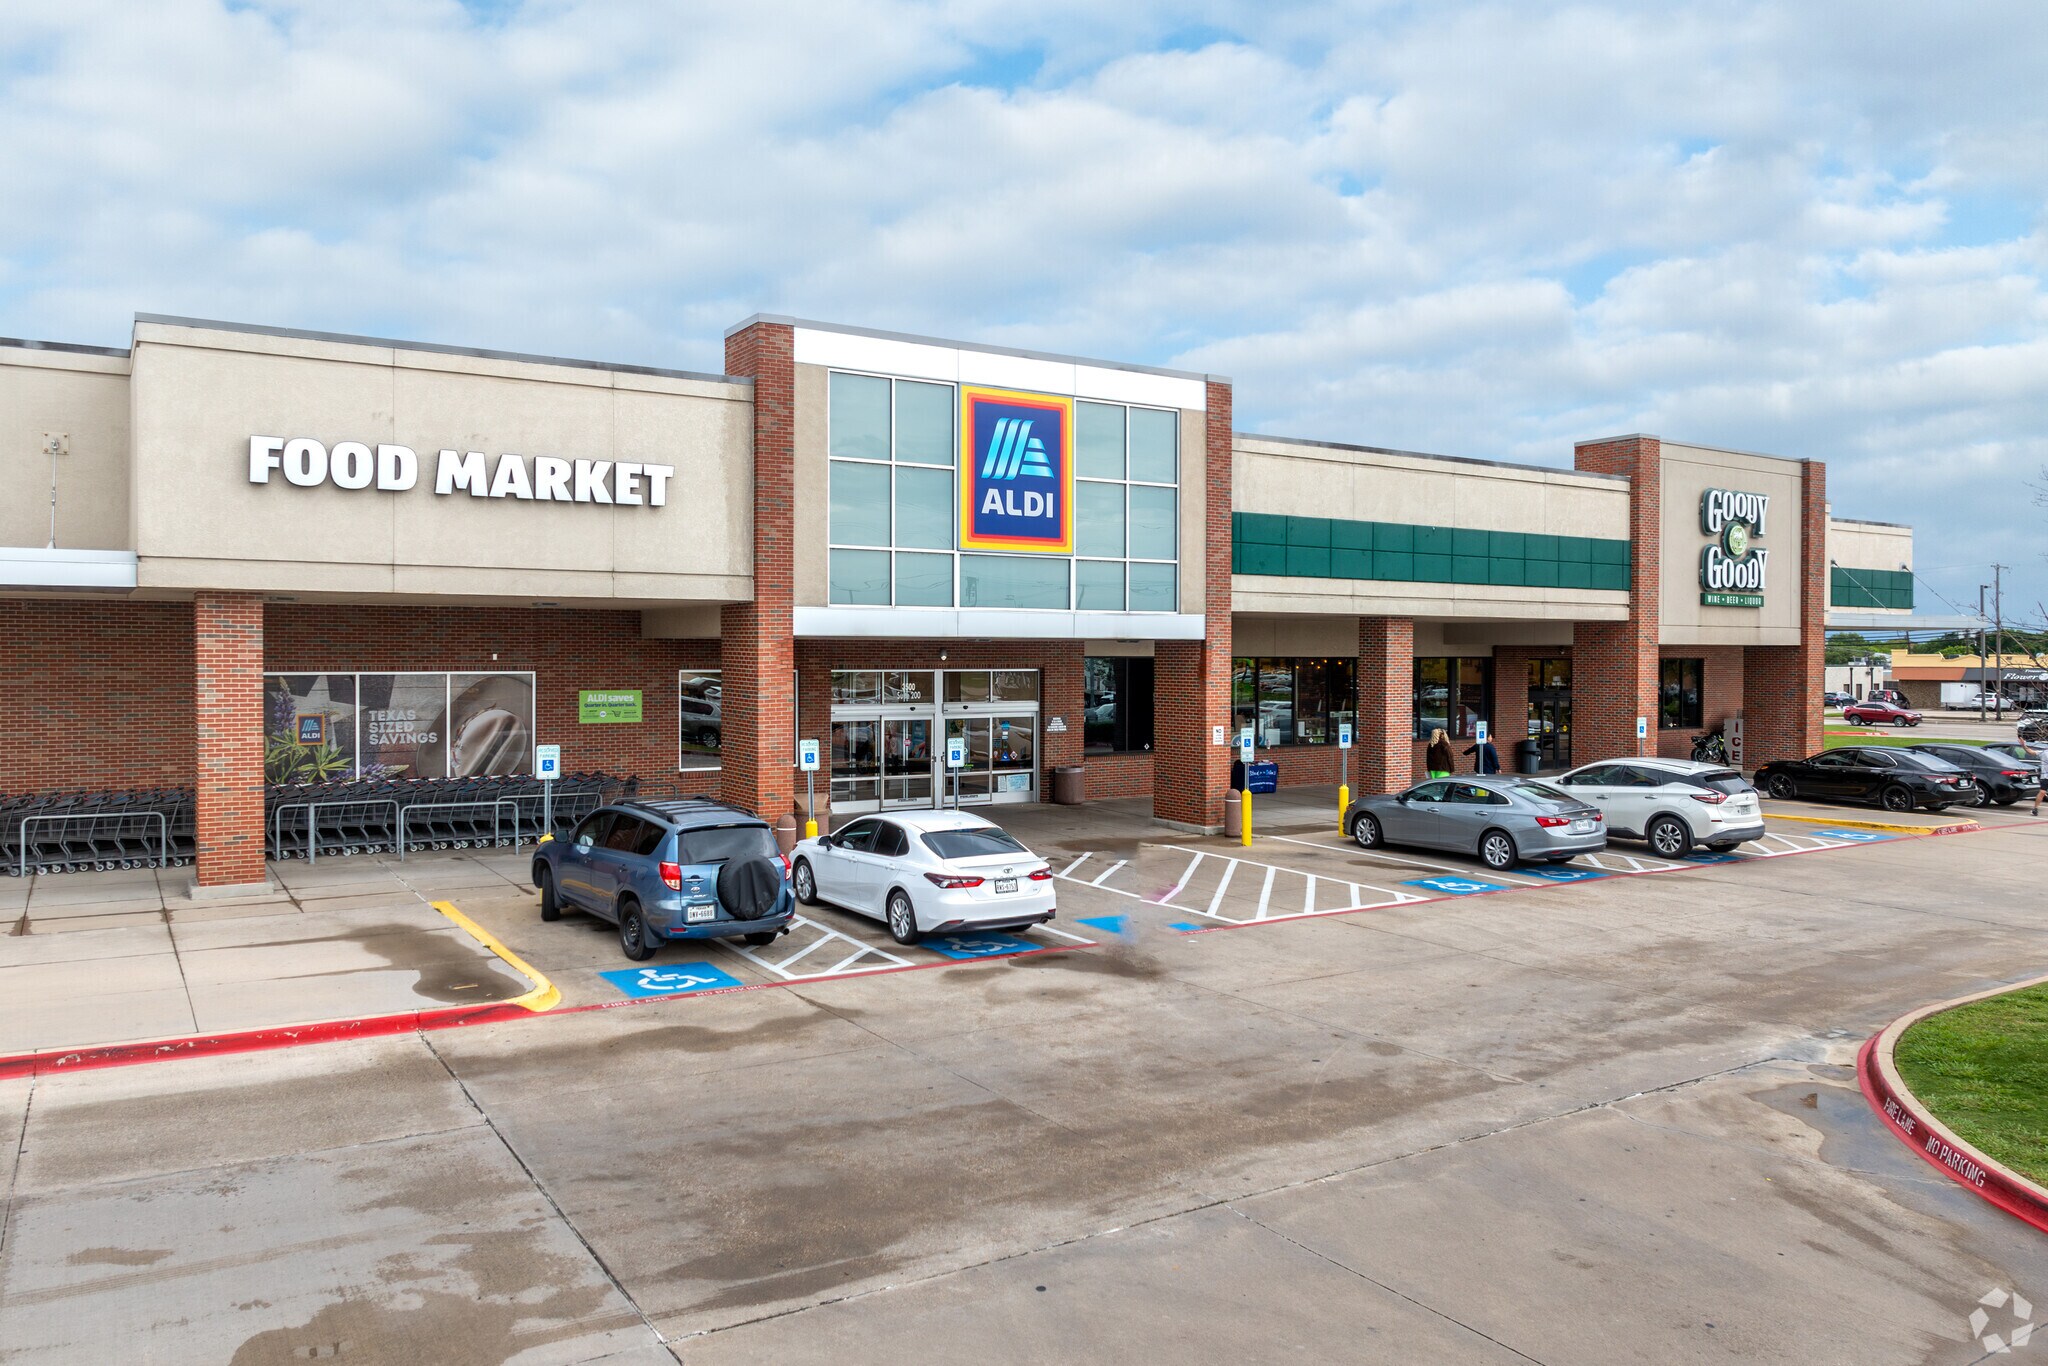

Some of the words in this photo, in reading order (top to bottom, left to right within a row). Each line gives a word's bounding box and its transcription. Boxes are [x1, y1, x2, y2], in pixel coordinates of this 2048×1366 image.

[249, 434, 419, 491] FOOD
[434, 449, 675, 508] MARKET
[981, 488, 1054, 518] ALDI
[1707, 490, 1770, 535] GOODY
[1707, 546, 1769, 589] GOODY
[1707, 595, 1720, 604] WINE
[1726, 595, 1739, 605] BEER
[1744, 597, 1762, 606] LIQUOR
[588, 694, 607, 702] ALDI
[608, 694, 634, 702] saves
[897, 691, 910, 700] Sue
[911, 691, 921, 699] 200
[368, 710, 416, 721] TEXAS
[369, 722, 414, 733] SIZED
[369, 732, 438, 746] SAVINGS
[1731, 721, 1742, 761] ICE
[601, 1001, 632, 1009] FIRE
[635, 996, 670, 1004] LANE
[716, 984, 767, 994] PARKING
[1883, 1097, 1899, 1119] FIRE
[1896, 1109, 1916, 1135] LANE
[1925, 1136, 1940, 1154] NO
[1939, 1145, 1986, 1187] PARKING
